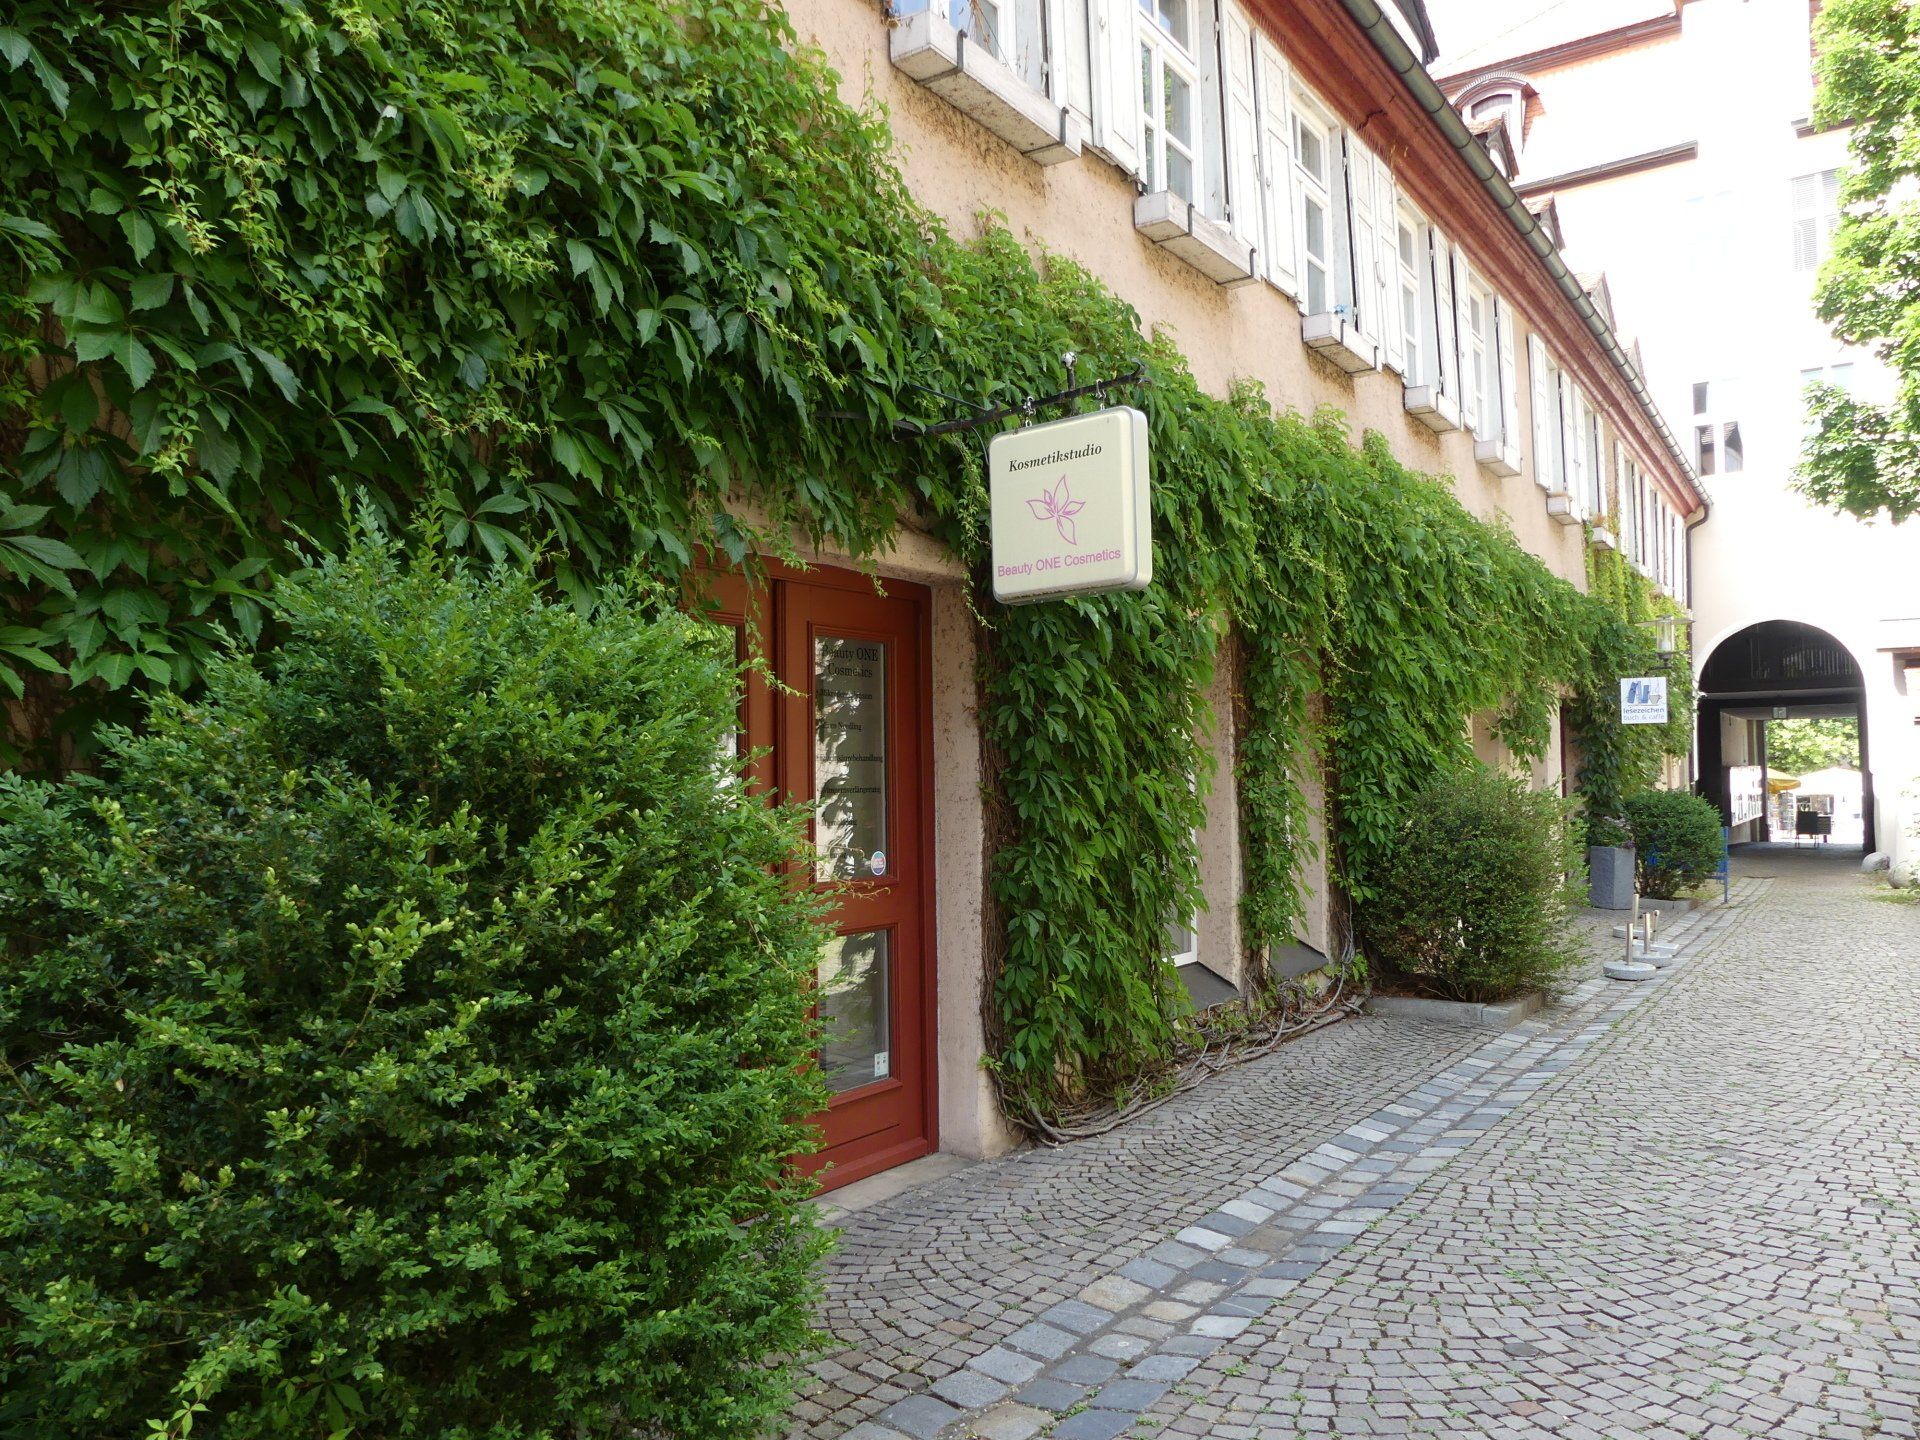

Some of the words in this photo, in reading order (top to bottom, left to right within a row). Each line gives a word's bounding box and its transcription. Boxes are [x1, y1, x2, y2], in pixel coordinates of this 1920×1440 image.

[1008, 443, 1103, 472] Kosmetikstudio
[997, 563, 1033, 577] Beauty
[1036, 556, 1061, 570] ONE
[1064, 549, 1121, 567] Cosmetics
[856, 647, 879, 661] ONE
